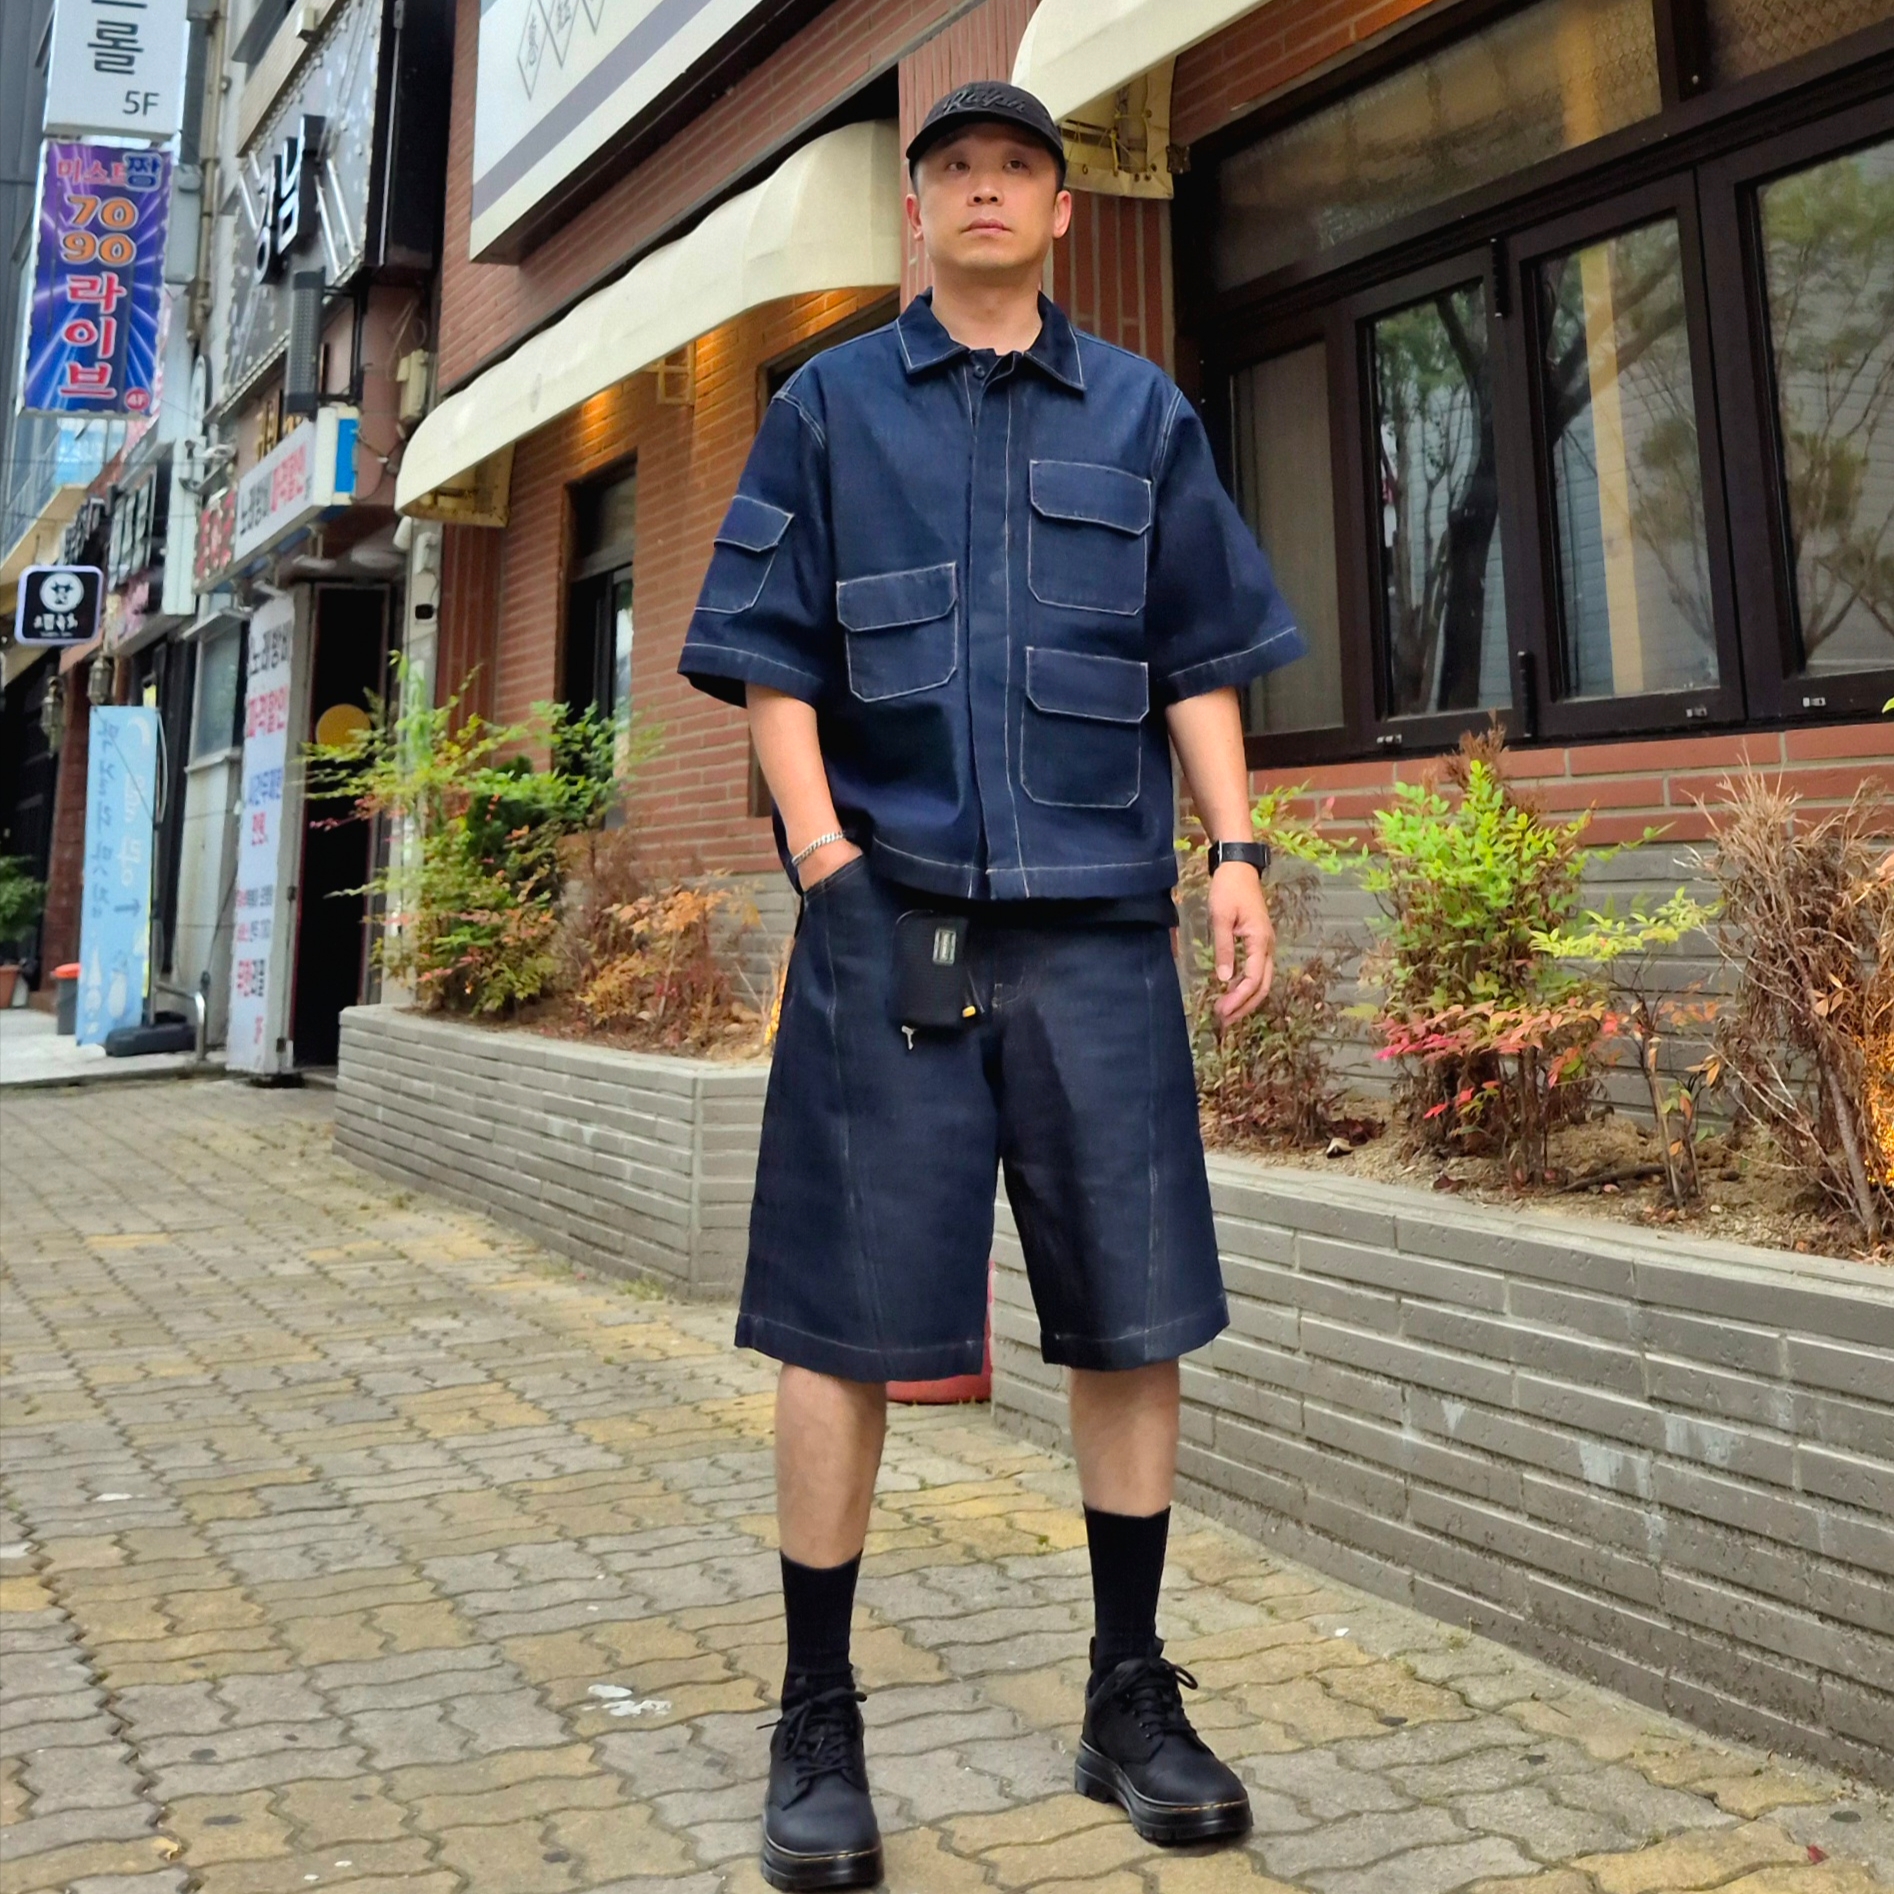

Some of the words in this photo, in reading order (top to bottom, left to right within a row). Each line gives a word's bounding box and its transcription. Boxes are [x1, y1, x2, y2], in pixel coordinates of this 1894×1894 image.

[87, 0, 148, 75] 롤
[121, 89, 160, 116] 5F
[65, 194, 139, 231] 70
[61, 230, 137, 267] 90
[57, 271, 128, 400] 라이브
[126, 391, 148, 407] 4F
